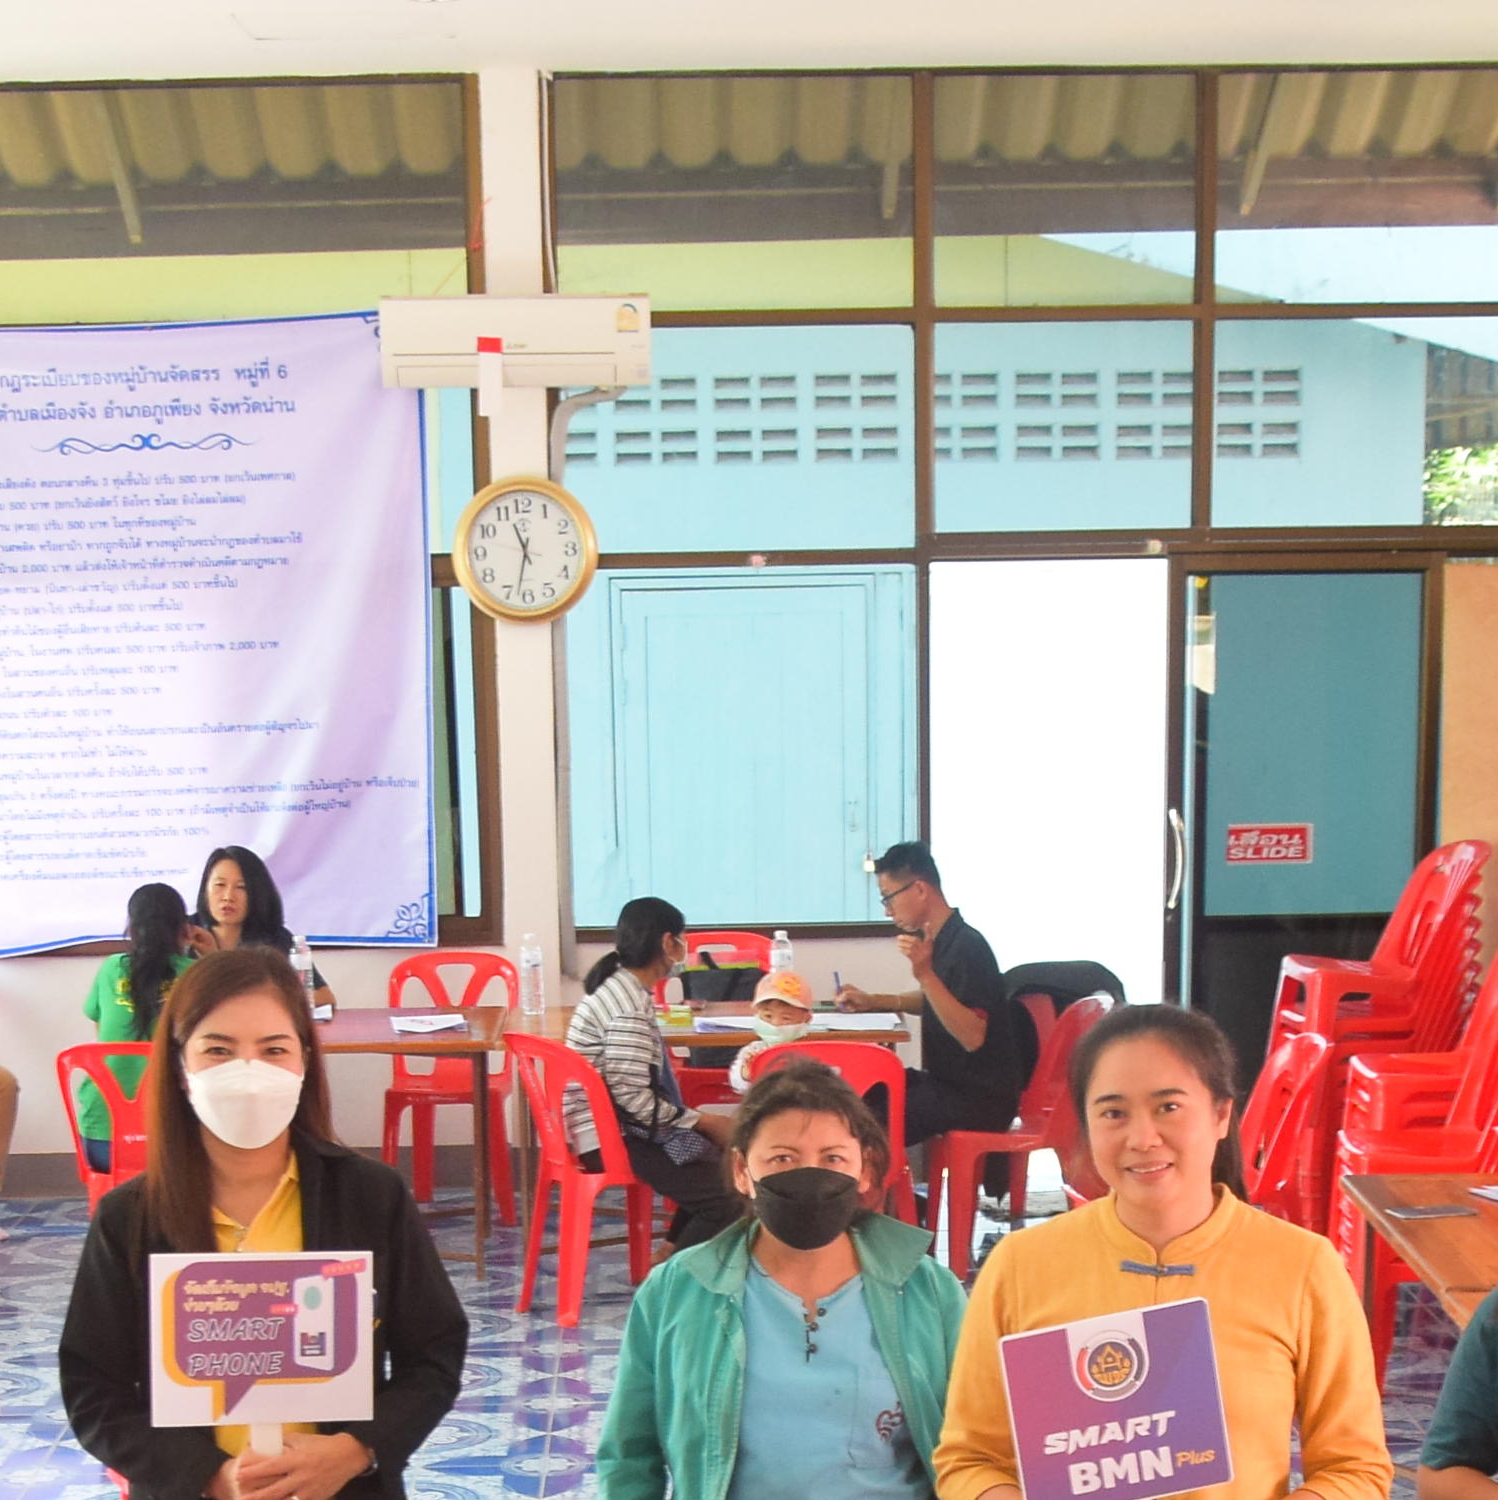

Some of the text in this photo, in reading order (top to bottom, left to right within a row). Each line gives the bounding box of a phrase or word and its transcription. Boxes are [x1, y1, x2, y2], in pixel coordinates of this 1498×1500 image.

[234, 356, 271, 389] หมู่ที่
[277, 363, 288, 380] 6
[104, 399, 202, 425] อำเภอภูเพียง
[209, 395, 297, 416] จังหวัดน่าน
[496, 503, 549, 522] 11 1
[513, 497, 533, 514] 12
[480, 519, 570, 540] 10 2
[473, 541, 578, 562] 9 3
[193, 573, 238, 590] บาทขึ้นไป
[482, 564, 571, 584] 8 4
[501, 582, 556, 605] 7 6 5
[1229, 846, 1304, 860] SLIDE
[187, 1316, 286, 1343] SMART
[187, 1351, 286, 1377] PHONE
[1042, 1410, 1176, 1456] SMART
[1068, 1446, 1216, 1496] BMN Plus
